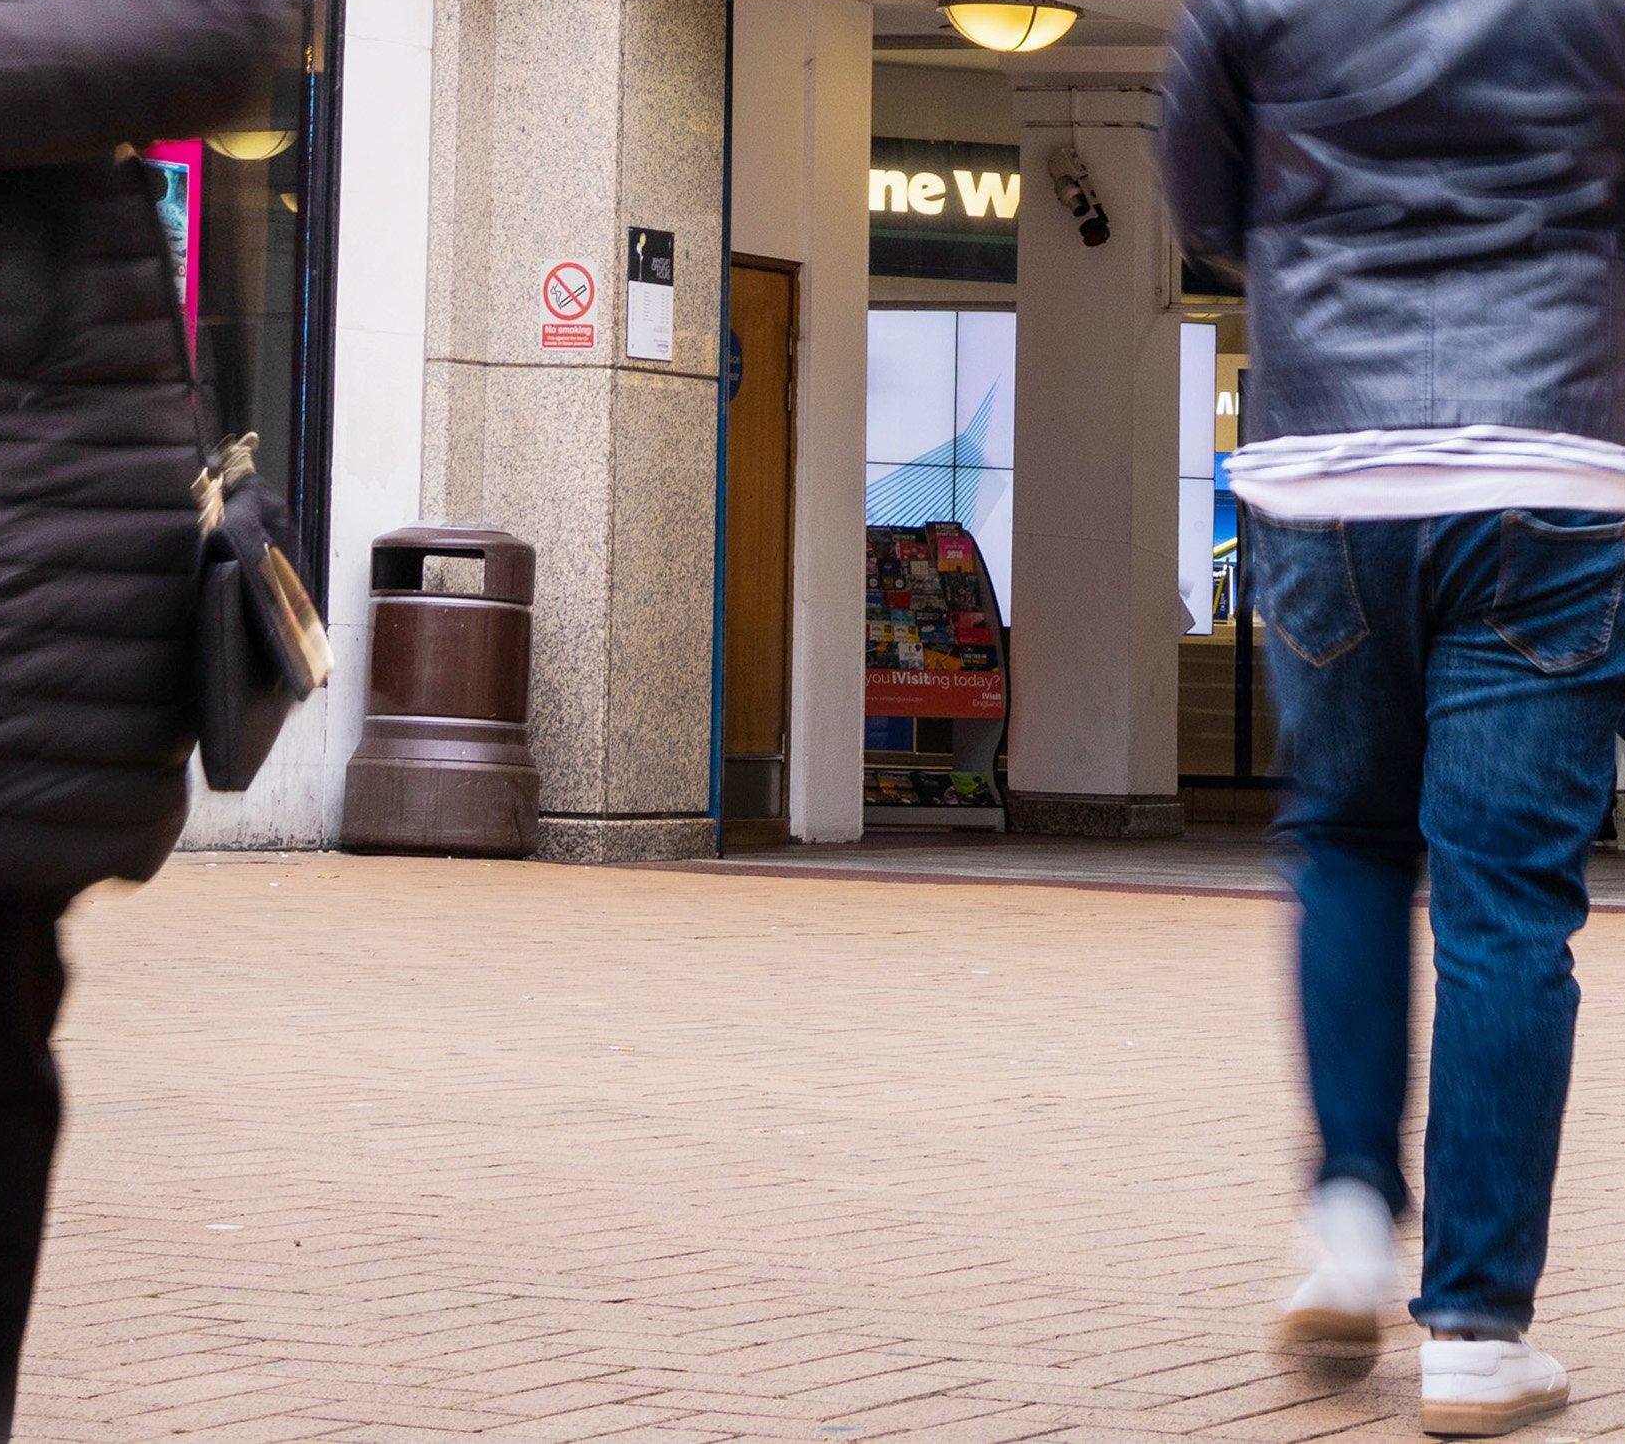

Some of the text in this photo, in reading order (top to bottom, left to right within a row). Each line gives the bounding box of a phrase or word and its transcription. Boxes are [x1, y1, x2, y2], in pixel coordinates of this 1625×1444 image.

[544, 325, 592, 336] No smoking
[865, 671, 891, 688] you
[953, 671, 1001, 690] today?
